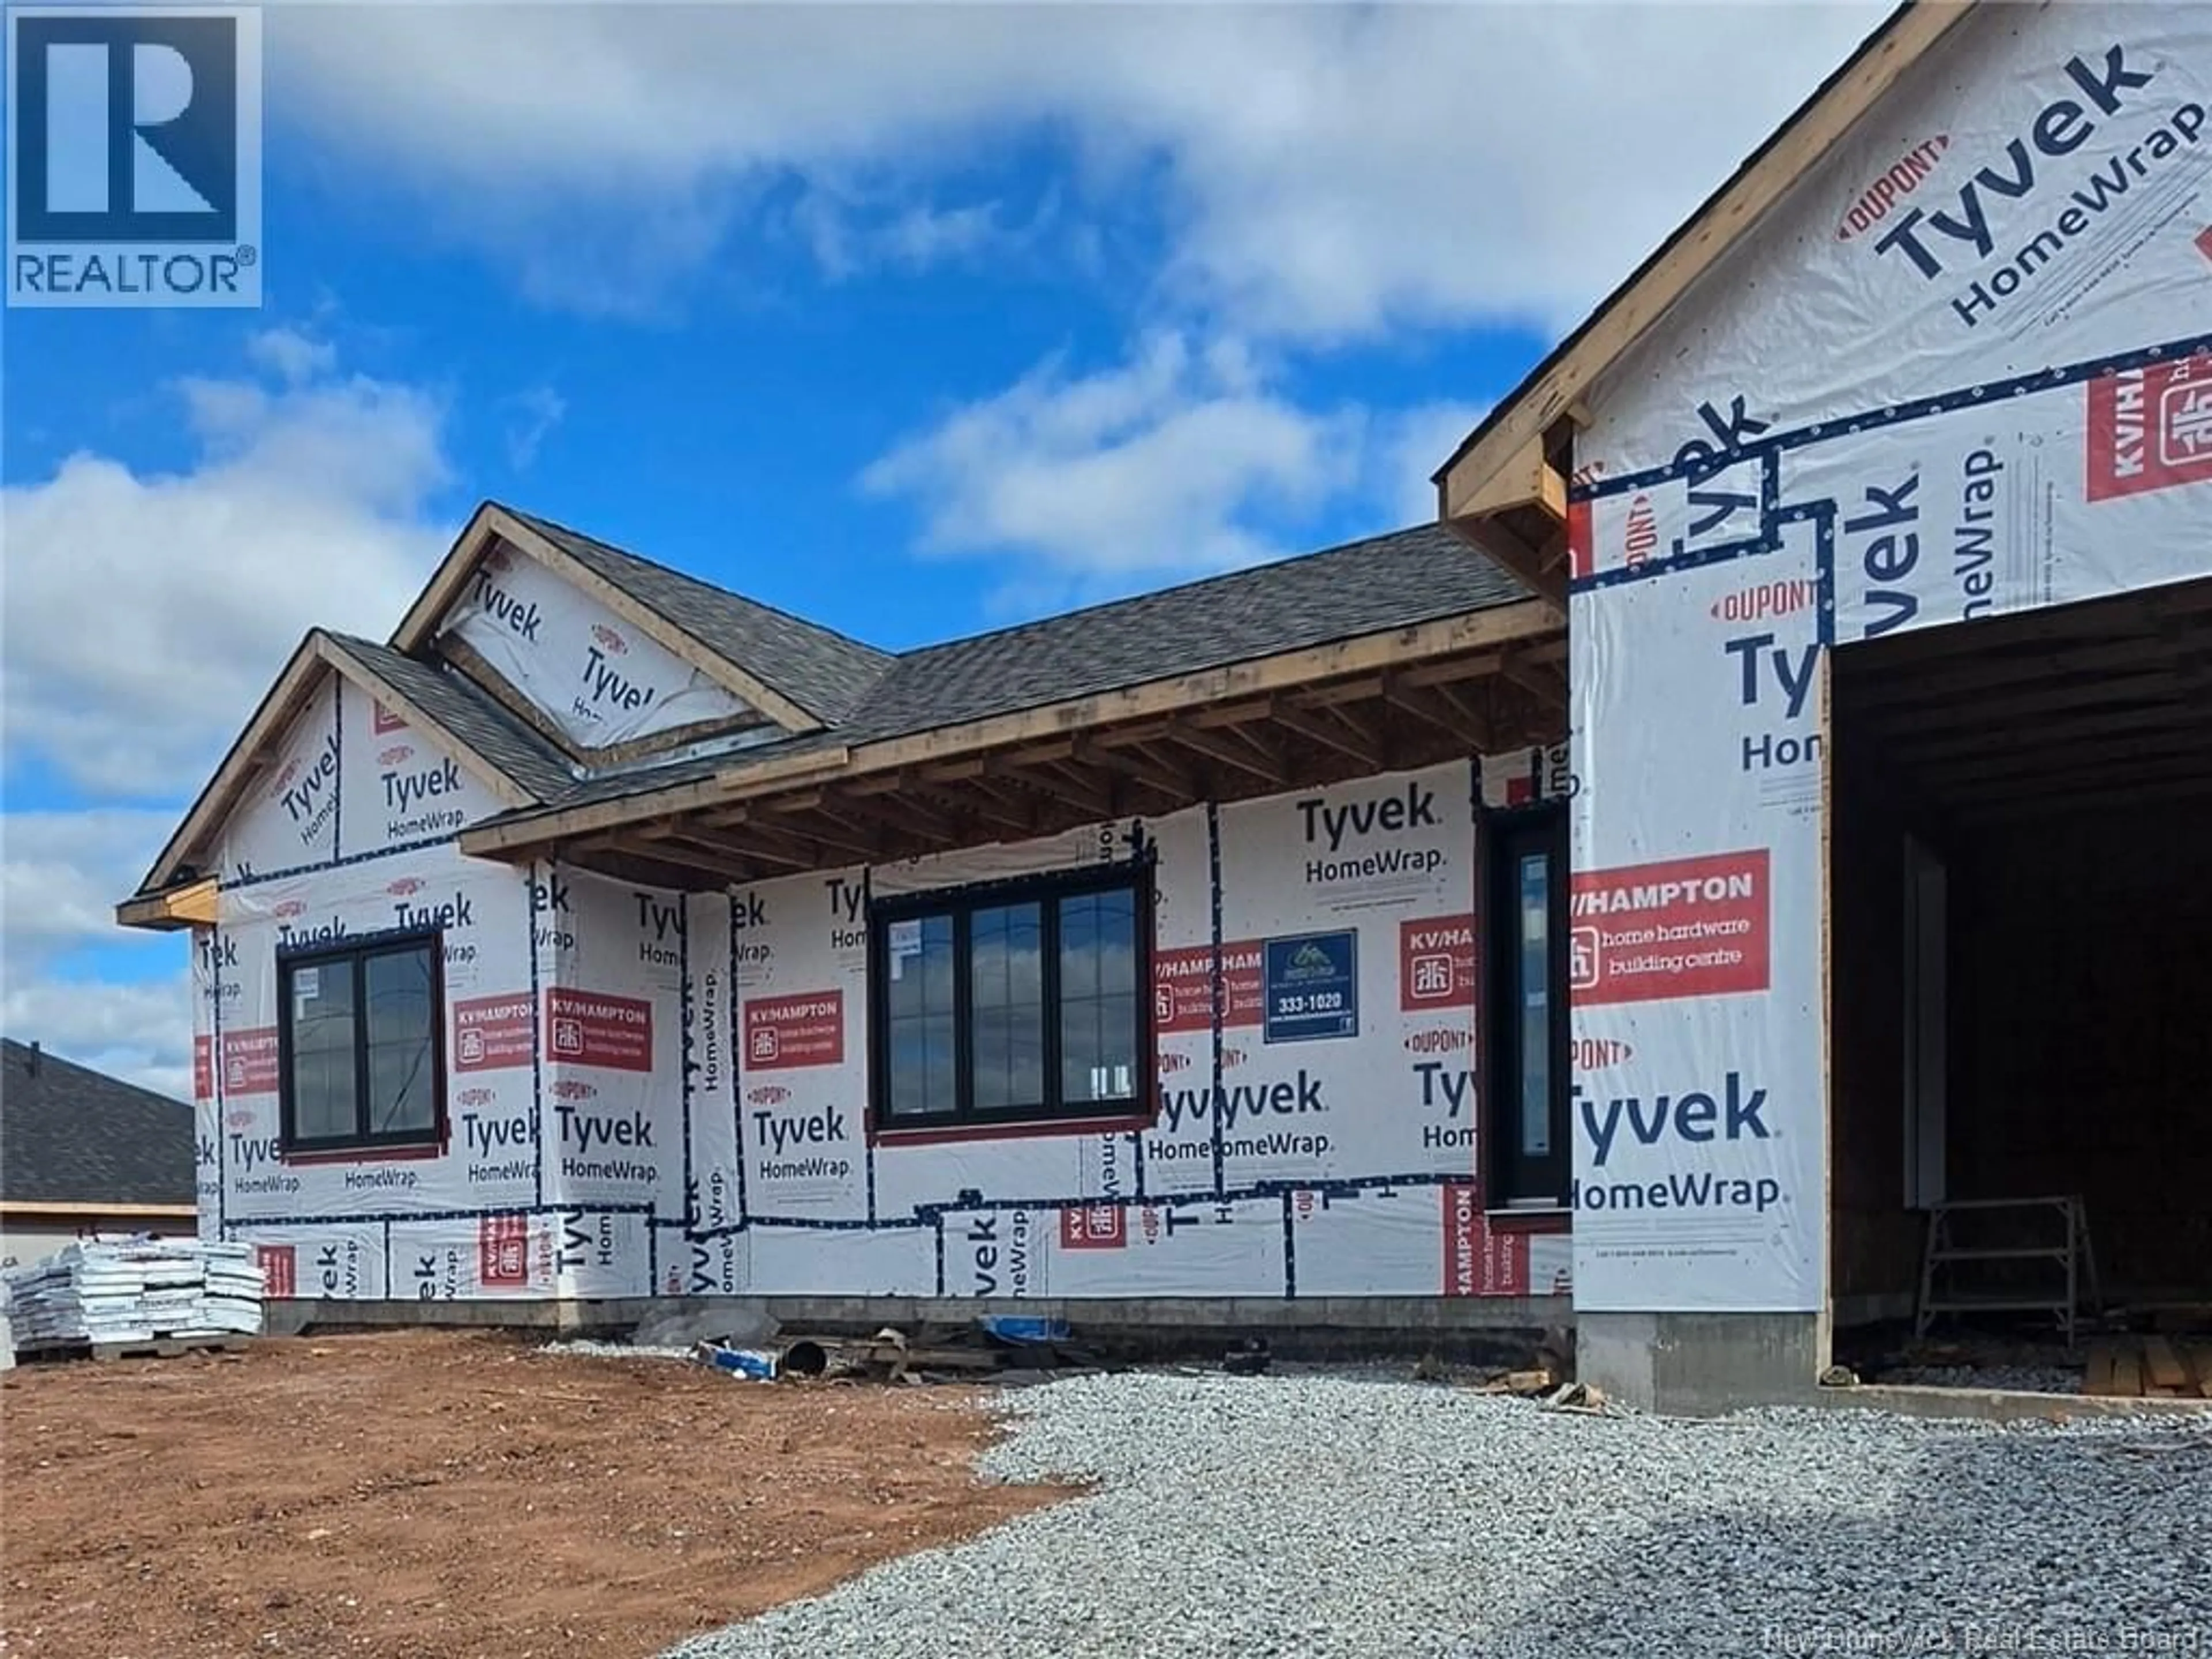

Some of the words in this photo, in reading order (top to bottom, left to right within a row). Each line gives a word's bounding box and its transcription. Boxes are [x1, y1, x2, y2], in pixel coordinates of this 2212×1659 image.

[1874, 44, 2154, 281] Tyvek
[1847, 139, 1941, 232] DUPONT
[1952, 103, 2206, 327] HomeWrap
[381, 757, 460, 813] Tyvek
[388, 809, 464, 839] HomeWrap
[1296, 782, 1436, 851] Tyvek
[1305, 846, 1442, 884] HomeWrap
[1602, 928, 1655, 948] home
[1656, 918, 1751, 944] hardware
[1608, 950, 1685, 976] building
[1684, 947, 1743, 969] centre
[1278, 991, 1343, 1013] 333-1020
[1412, 1029, 1466, 1054] DUPONT
[554, 1105, 653, 1154] Tyvek
[753, 1105, 844, 1154] Tyvek
[345, 1170, 416, 1191] HomeWrap
[562, 1157, 657, 1181] HomeWrap
[760, 1157, 850, 1180] HomeWrap
